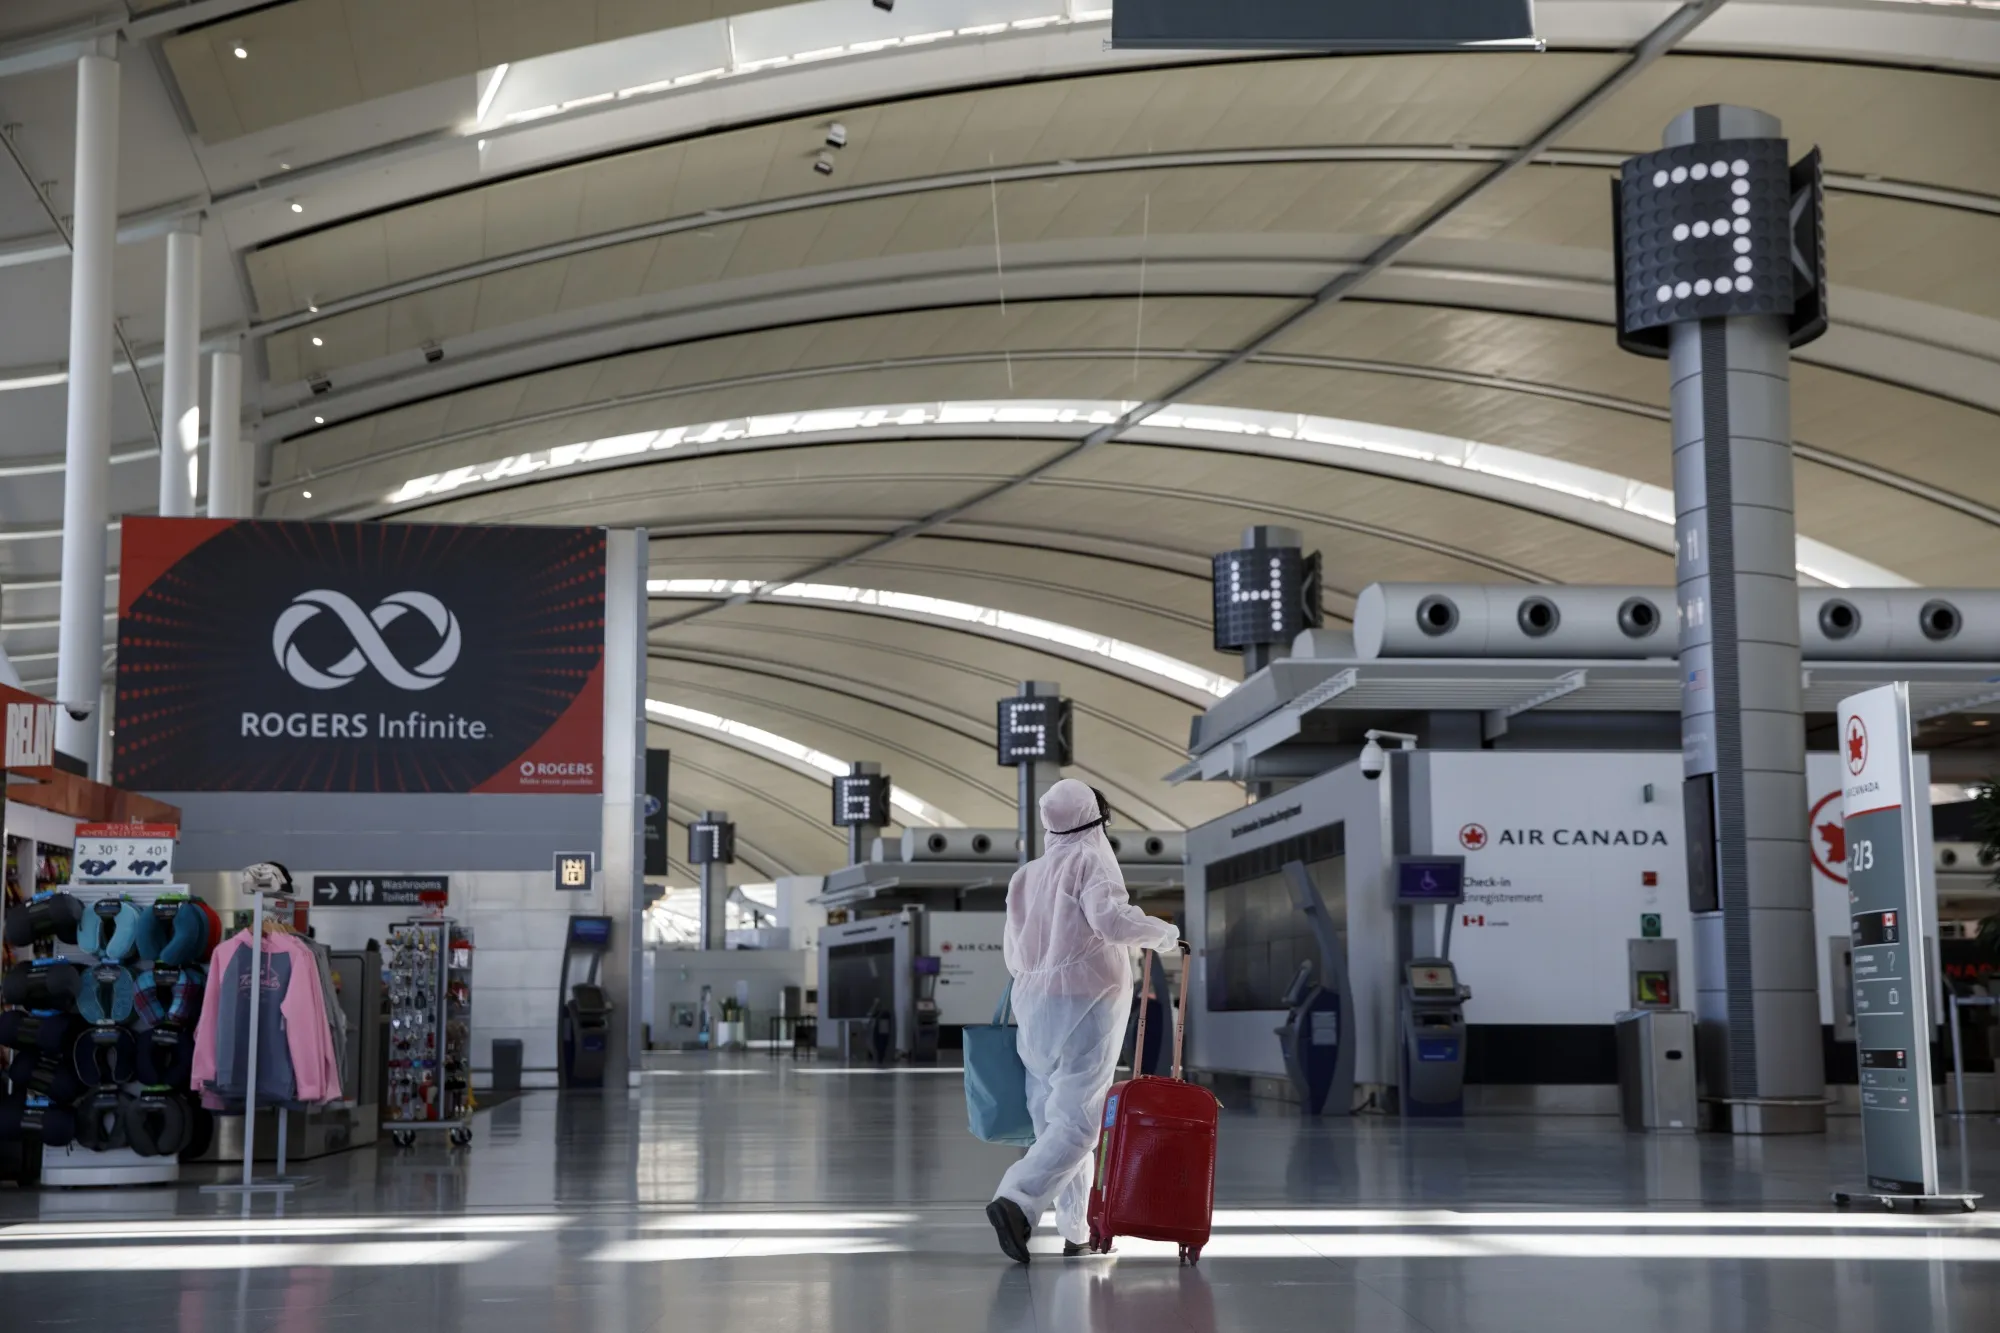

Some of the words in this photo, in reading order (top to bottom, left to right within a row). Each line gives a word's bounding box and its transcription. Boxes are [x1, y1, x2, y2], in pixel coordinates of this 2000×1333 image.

[1652, 158, 1754, 303] 3
[1230, 557, 1283, 632] 4
[240, 712, 368, 738] ROGERS
[1010, 702, 1046, 756] 5
[538, 762, 594, 776] ROGERS
[843, 778, 870, 820] 6
[696, 824, 720, 859] 7
[1499, 829, 1545, 846] AIR
[1552, 829, 1669, 847] CANADA
[79, 844, 86, 855] 2
[127, 845, 135, 855] 2
[381, 879, 442, 890] Washrooms
[381, 891, 420, 903] Toilette
[957, 943, 976, 952] AIR
